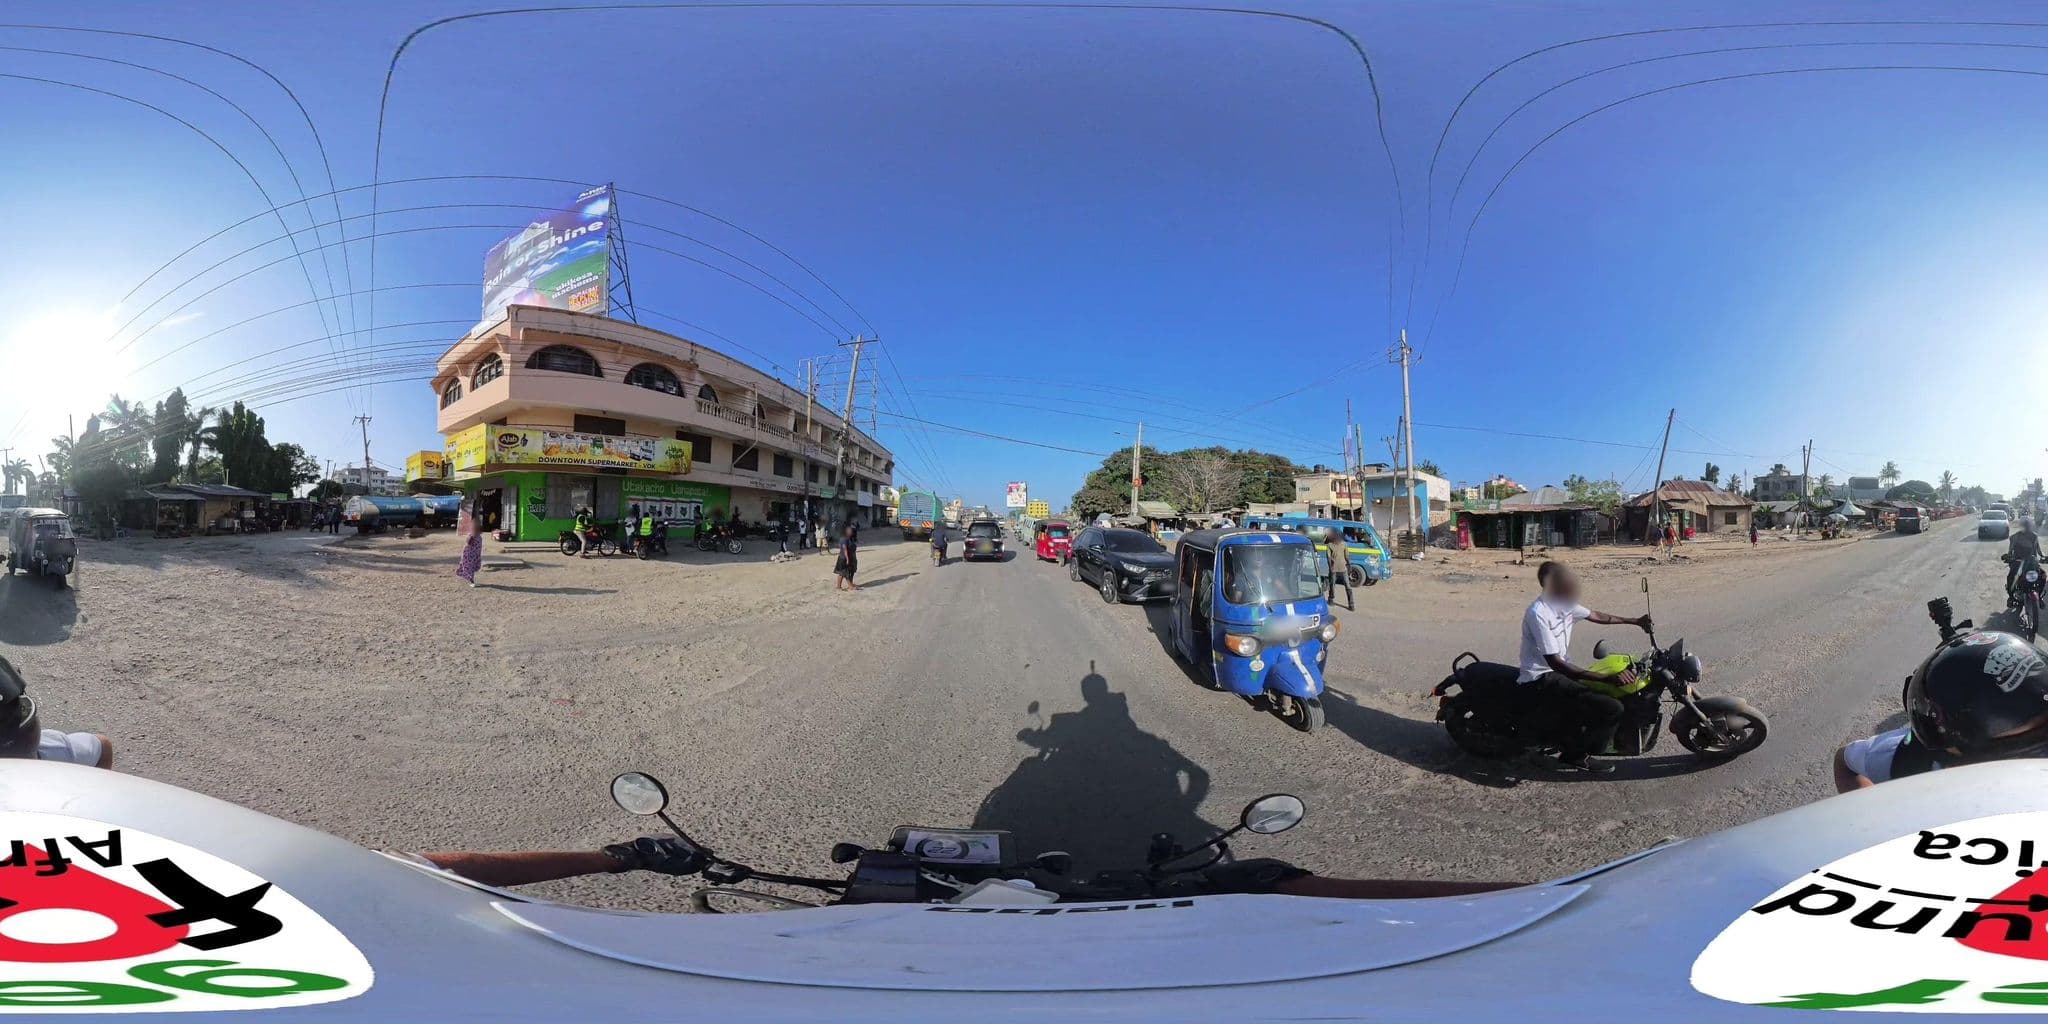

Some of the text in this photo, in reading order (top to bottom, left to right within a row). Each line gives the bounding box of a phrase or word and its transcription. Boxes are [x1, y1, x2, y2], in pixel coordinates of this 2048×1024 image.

[485, 264, 512, 294] Rain
[516, 251, 532, 266] or
[538, 456, 586, 465] DOWNTOWN
[587, 459, 638, 468] SUPERMARKET
